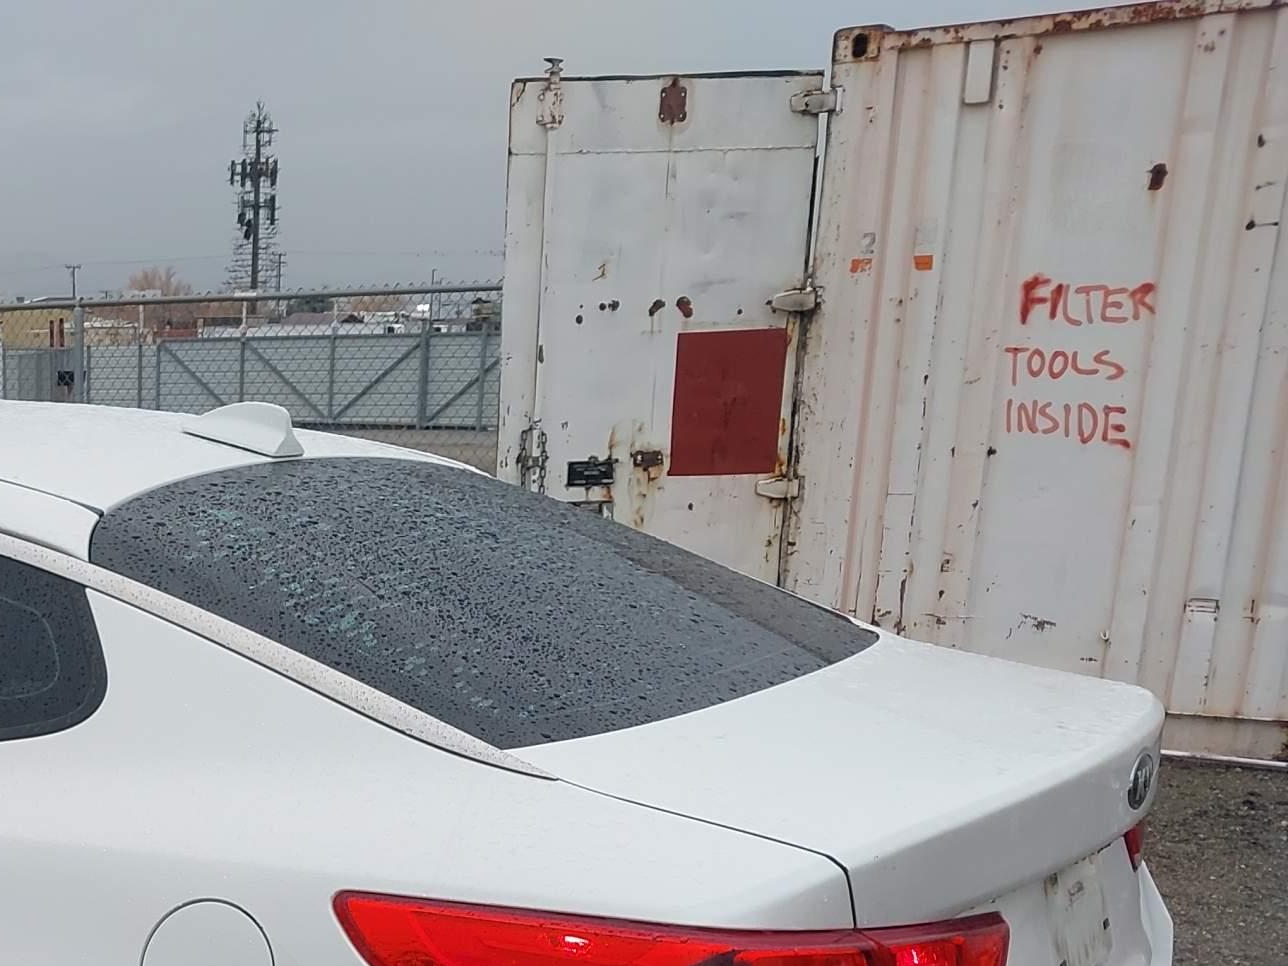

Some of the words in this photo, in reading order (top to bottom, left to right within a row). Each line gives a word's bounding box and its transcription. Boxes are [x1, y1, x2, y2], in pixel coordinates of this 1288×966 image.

[1020, 275, 1156, 326] FILTER
[1004, 347, 1125, 386] TOOLS
[1006, 398, 1130, 449] INSIDE
